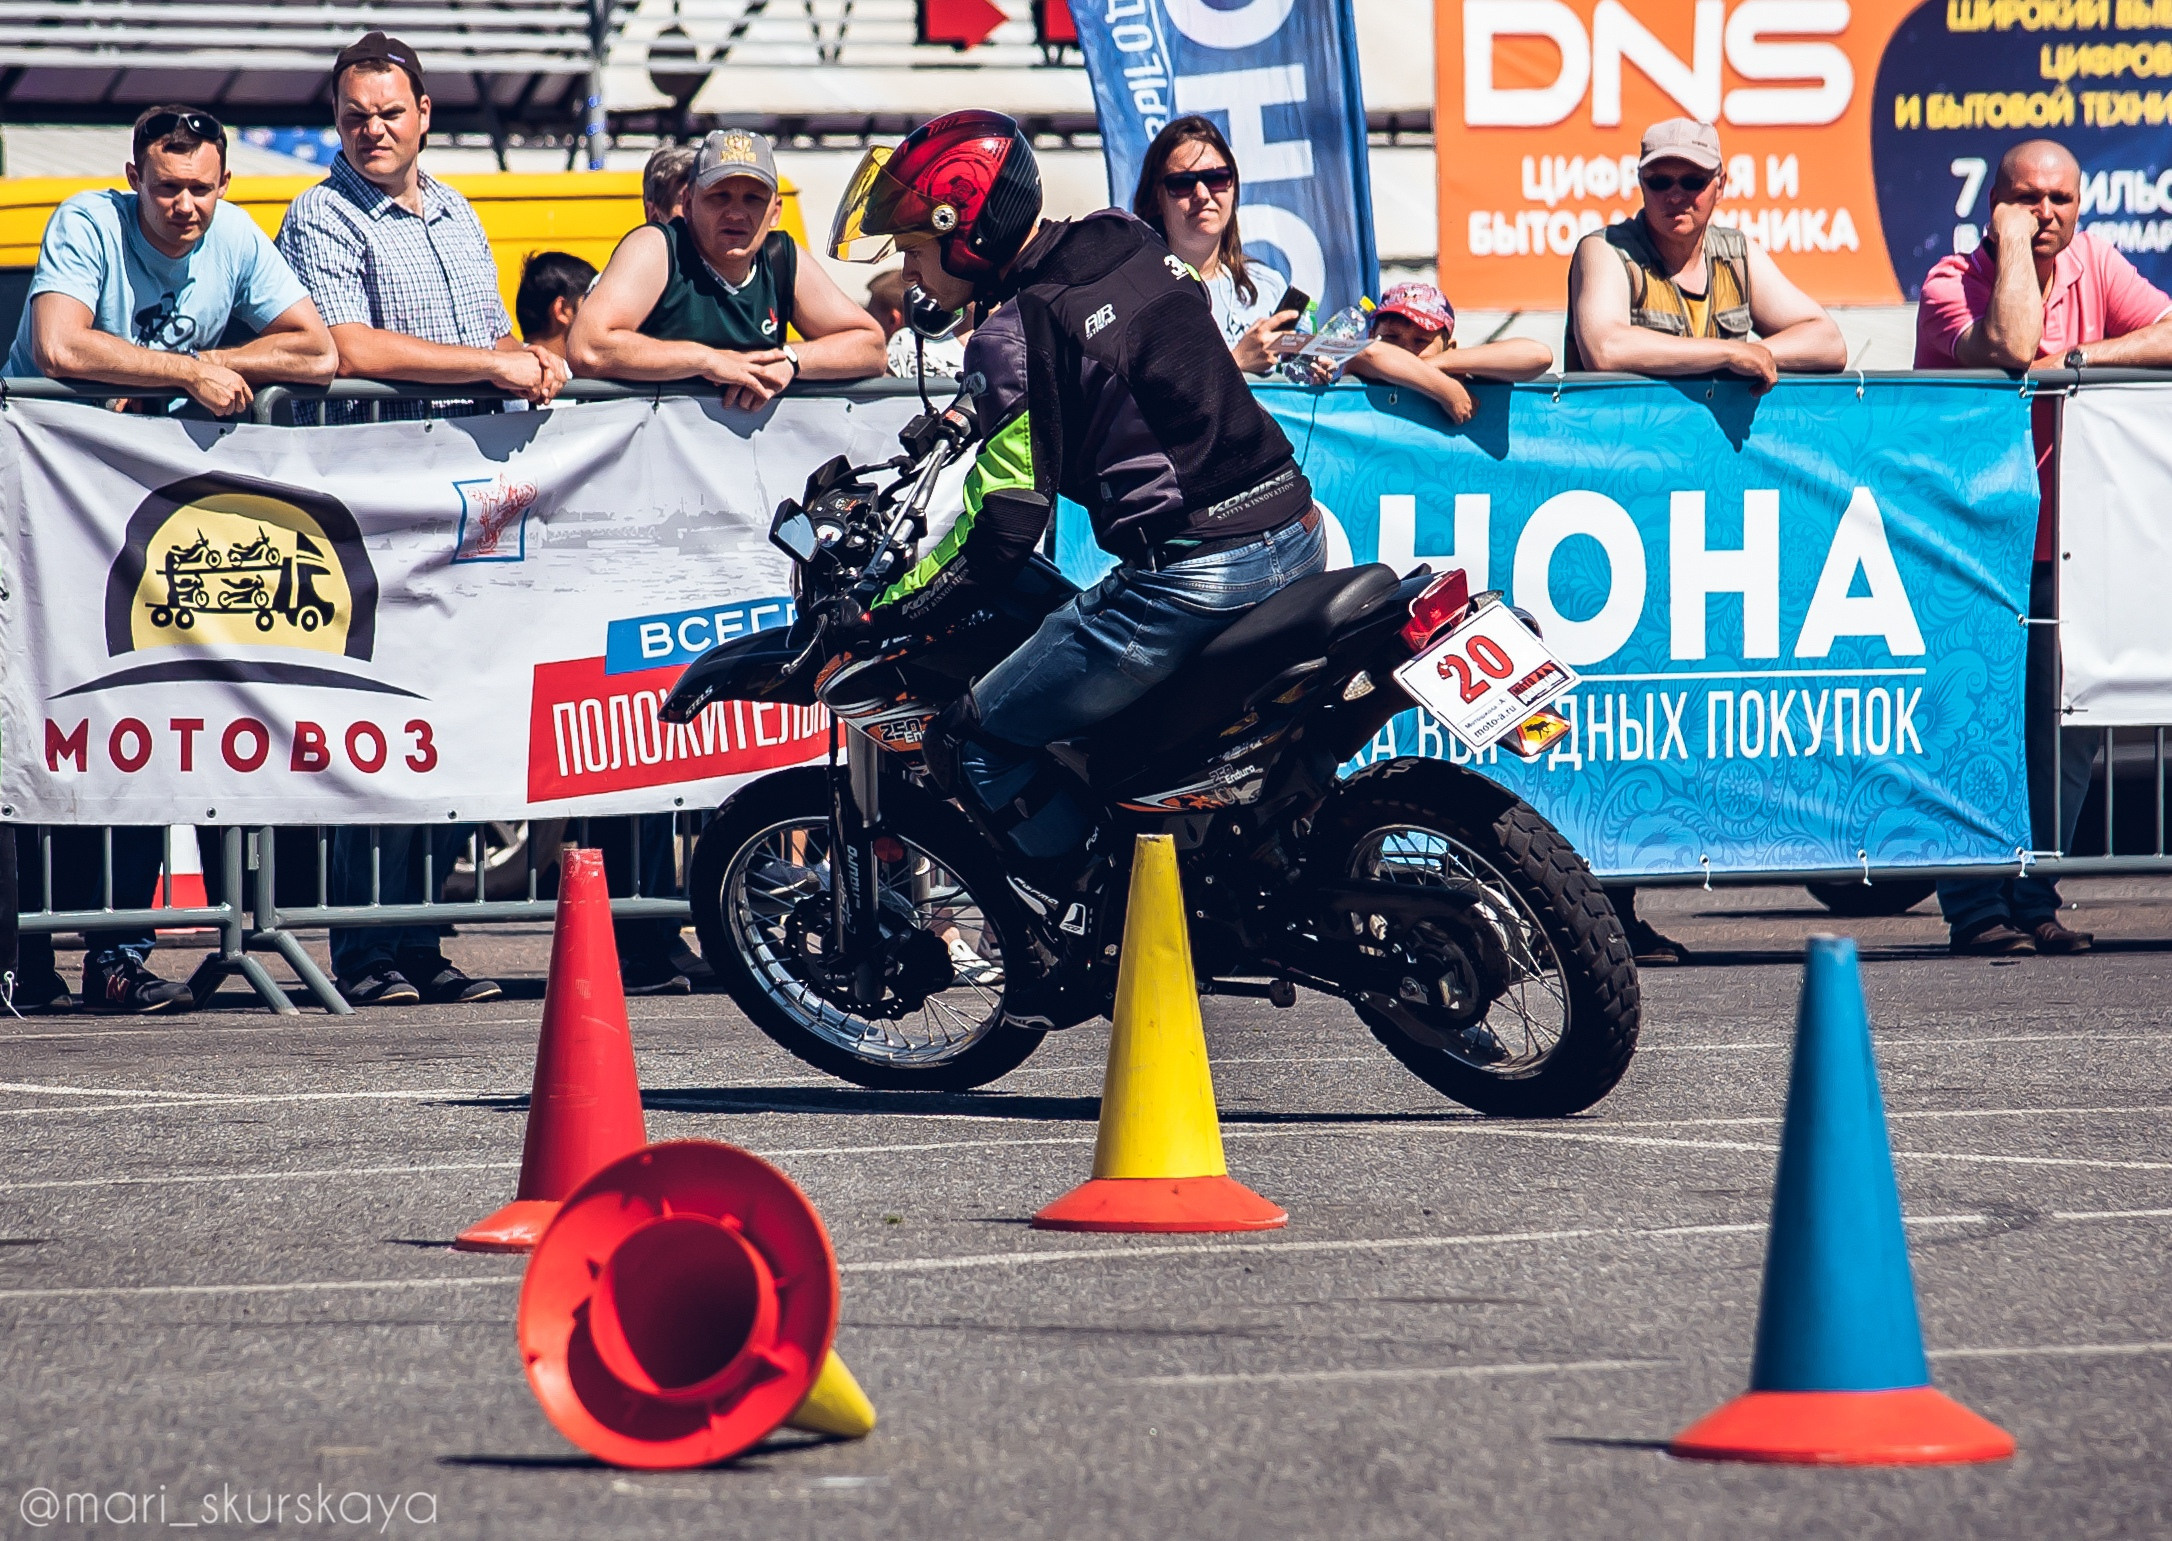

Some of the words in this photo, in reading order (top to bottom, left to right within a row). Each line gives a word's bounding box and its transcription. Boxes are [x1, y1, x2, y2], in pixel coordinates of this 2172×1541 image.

[1464, 0, 1855, 127] DNS
[1895, 93, 1921, 130] И
[1926, 83, 2076, 131] БЫТОВОЙ
[1521, 153, 1756, 208] ЦИФРЯ
[1766, 153, 1799, 199] И
[1951, 158, 1988, 218] 7
[1207, 469, 1296, 517] KOMINE
[1306, 486, 1926, 667] НОНА
[1437, 635, 1514, 704] 20
[44, 716, 439, 774] МОТОВОЗ
[1474, 705, 1517, 738] moto-a.ru
[1707, 687, 1923, 759] ПОКУПОК
[1224, 764, 1256, 785] Enduro
